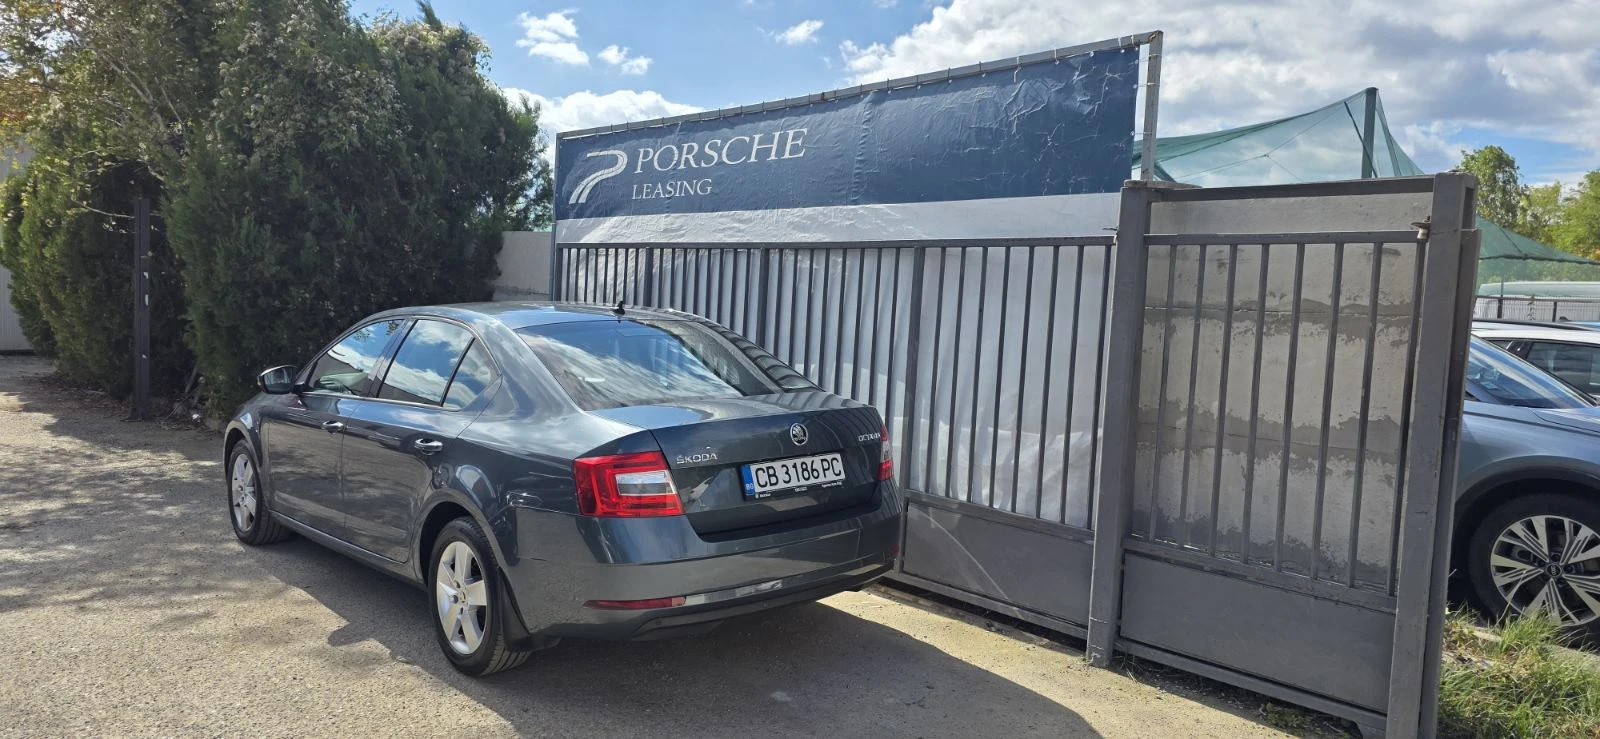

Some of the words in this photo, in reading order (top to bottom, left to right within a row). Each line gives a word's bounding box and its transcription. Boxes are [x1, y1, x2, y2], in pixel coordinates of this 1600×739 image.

[634, 128, 808, 174] PORSCHE
[631, 178, 713, 200] LEASING
[755, 466, 779, 488] CB
[781, 460, 820, 484] 3186
[820, 457, 842, 478] PC
[745, 483, 754, 491] BG
